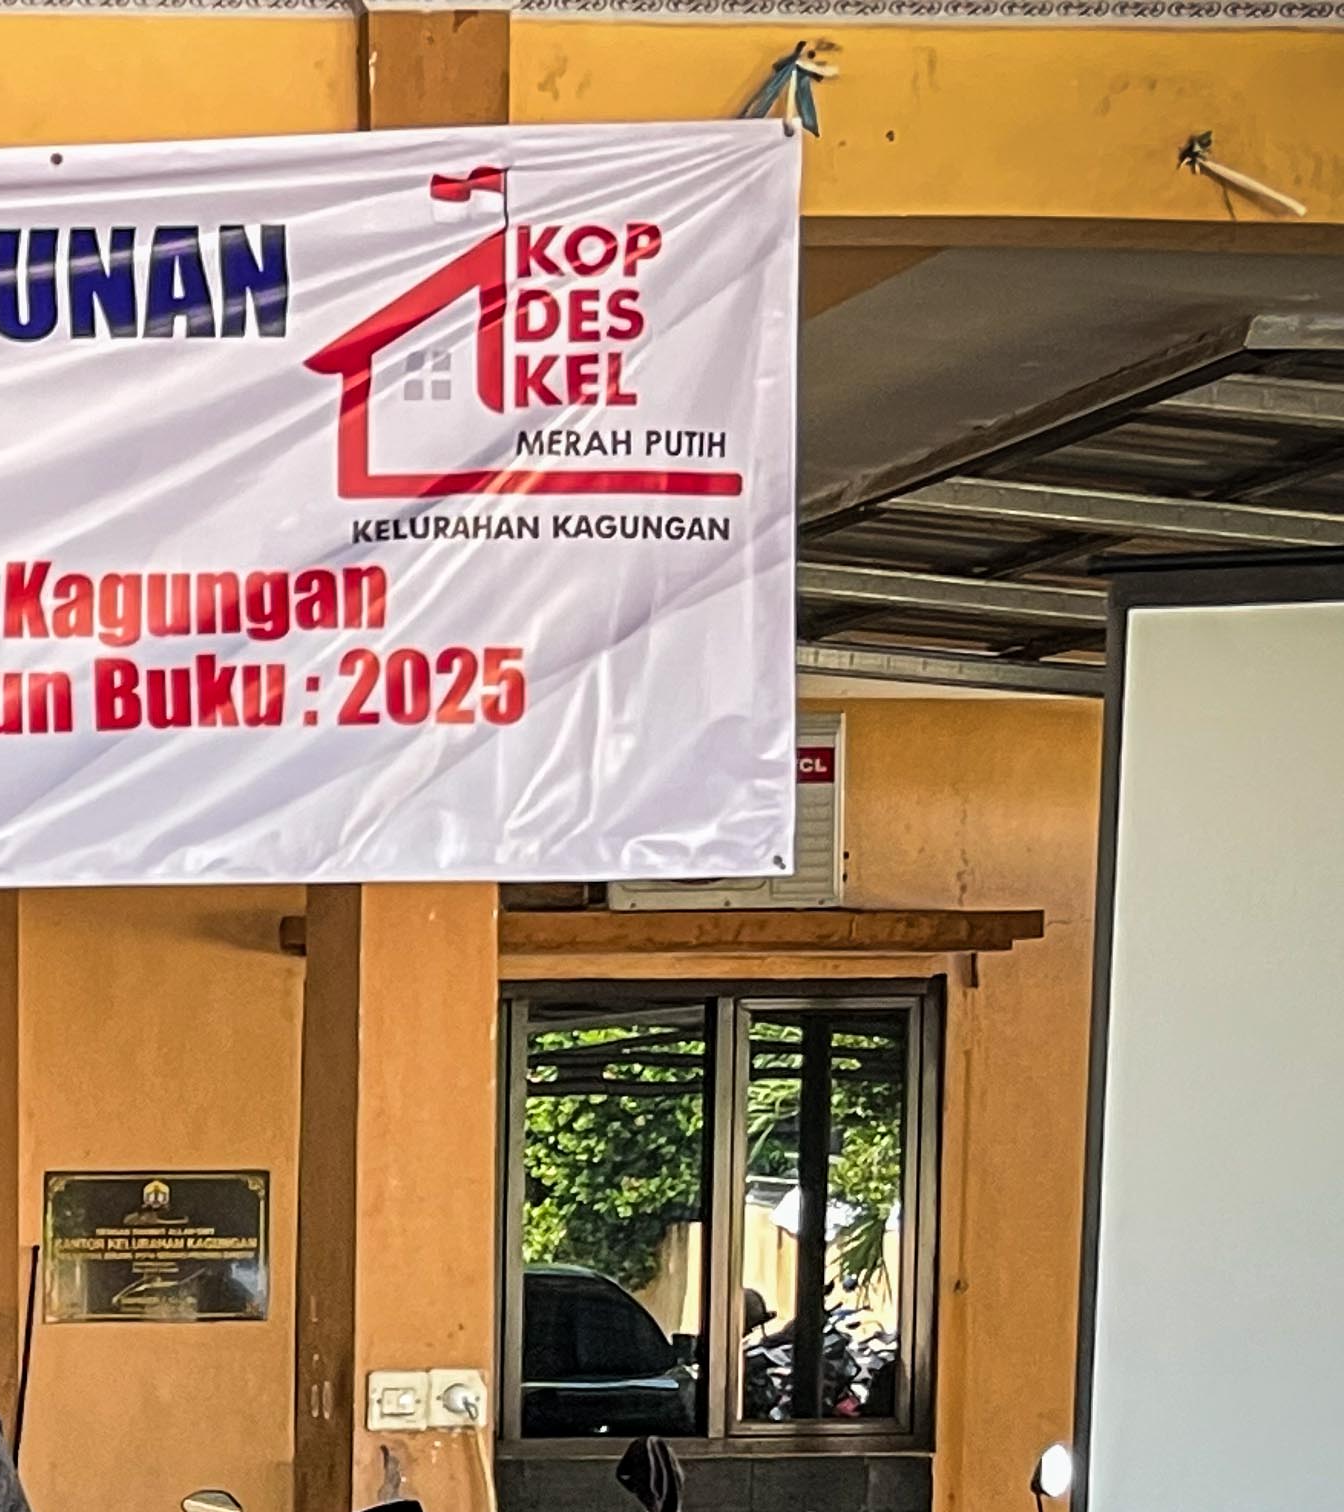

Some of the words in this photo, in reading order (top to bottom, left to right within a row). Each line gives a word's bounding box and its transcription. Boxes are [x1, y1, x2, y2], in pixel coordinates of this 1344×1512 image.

[516, 223, 662, 278] KOP
[515, 289, 645, 343] DES
[514, 352, 638, 408] KEL
[515, 430, 632, 457] MERAH
[644, 430, 727, 458] PUTIH
[352, 515, 540, 543] KELURAHAN
[552, 515, 730, 541] KAGUNGAN
[2, 560, 388, 647] Kagungan
[93, 653, 286, 732] Buku
[304, 674, 319, 727] :
[337, 646, 528, 727] 2025
[796, 757, 828, 773] CL
